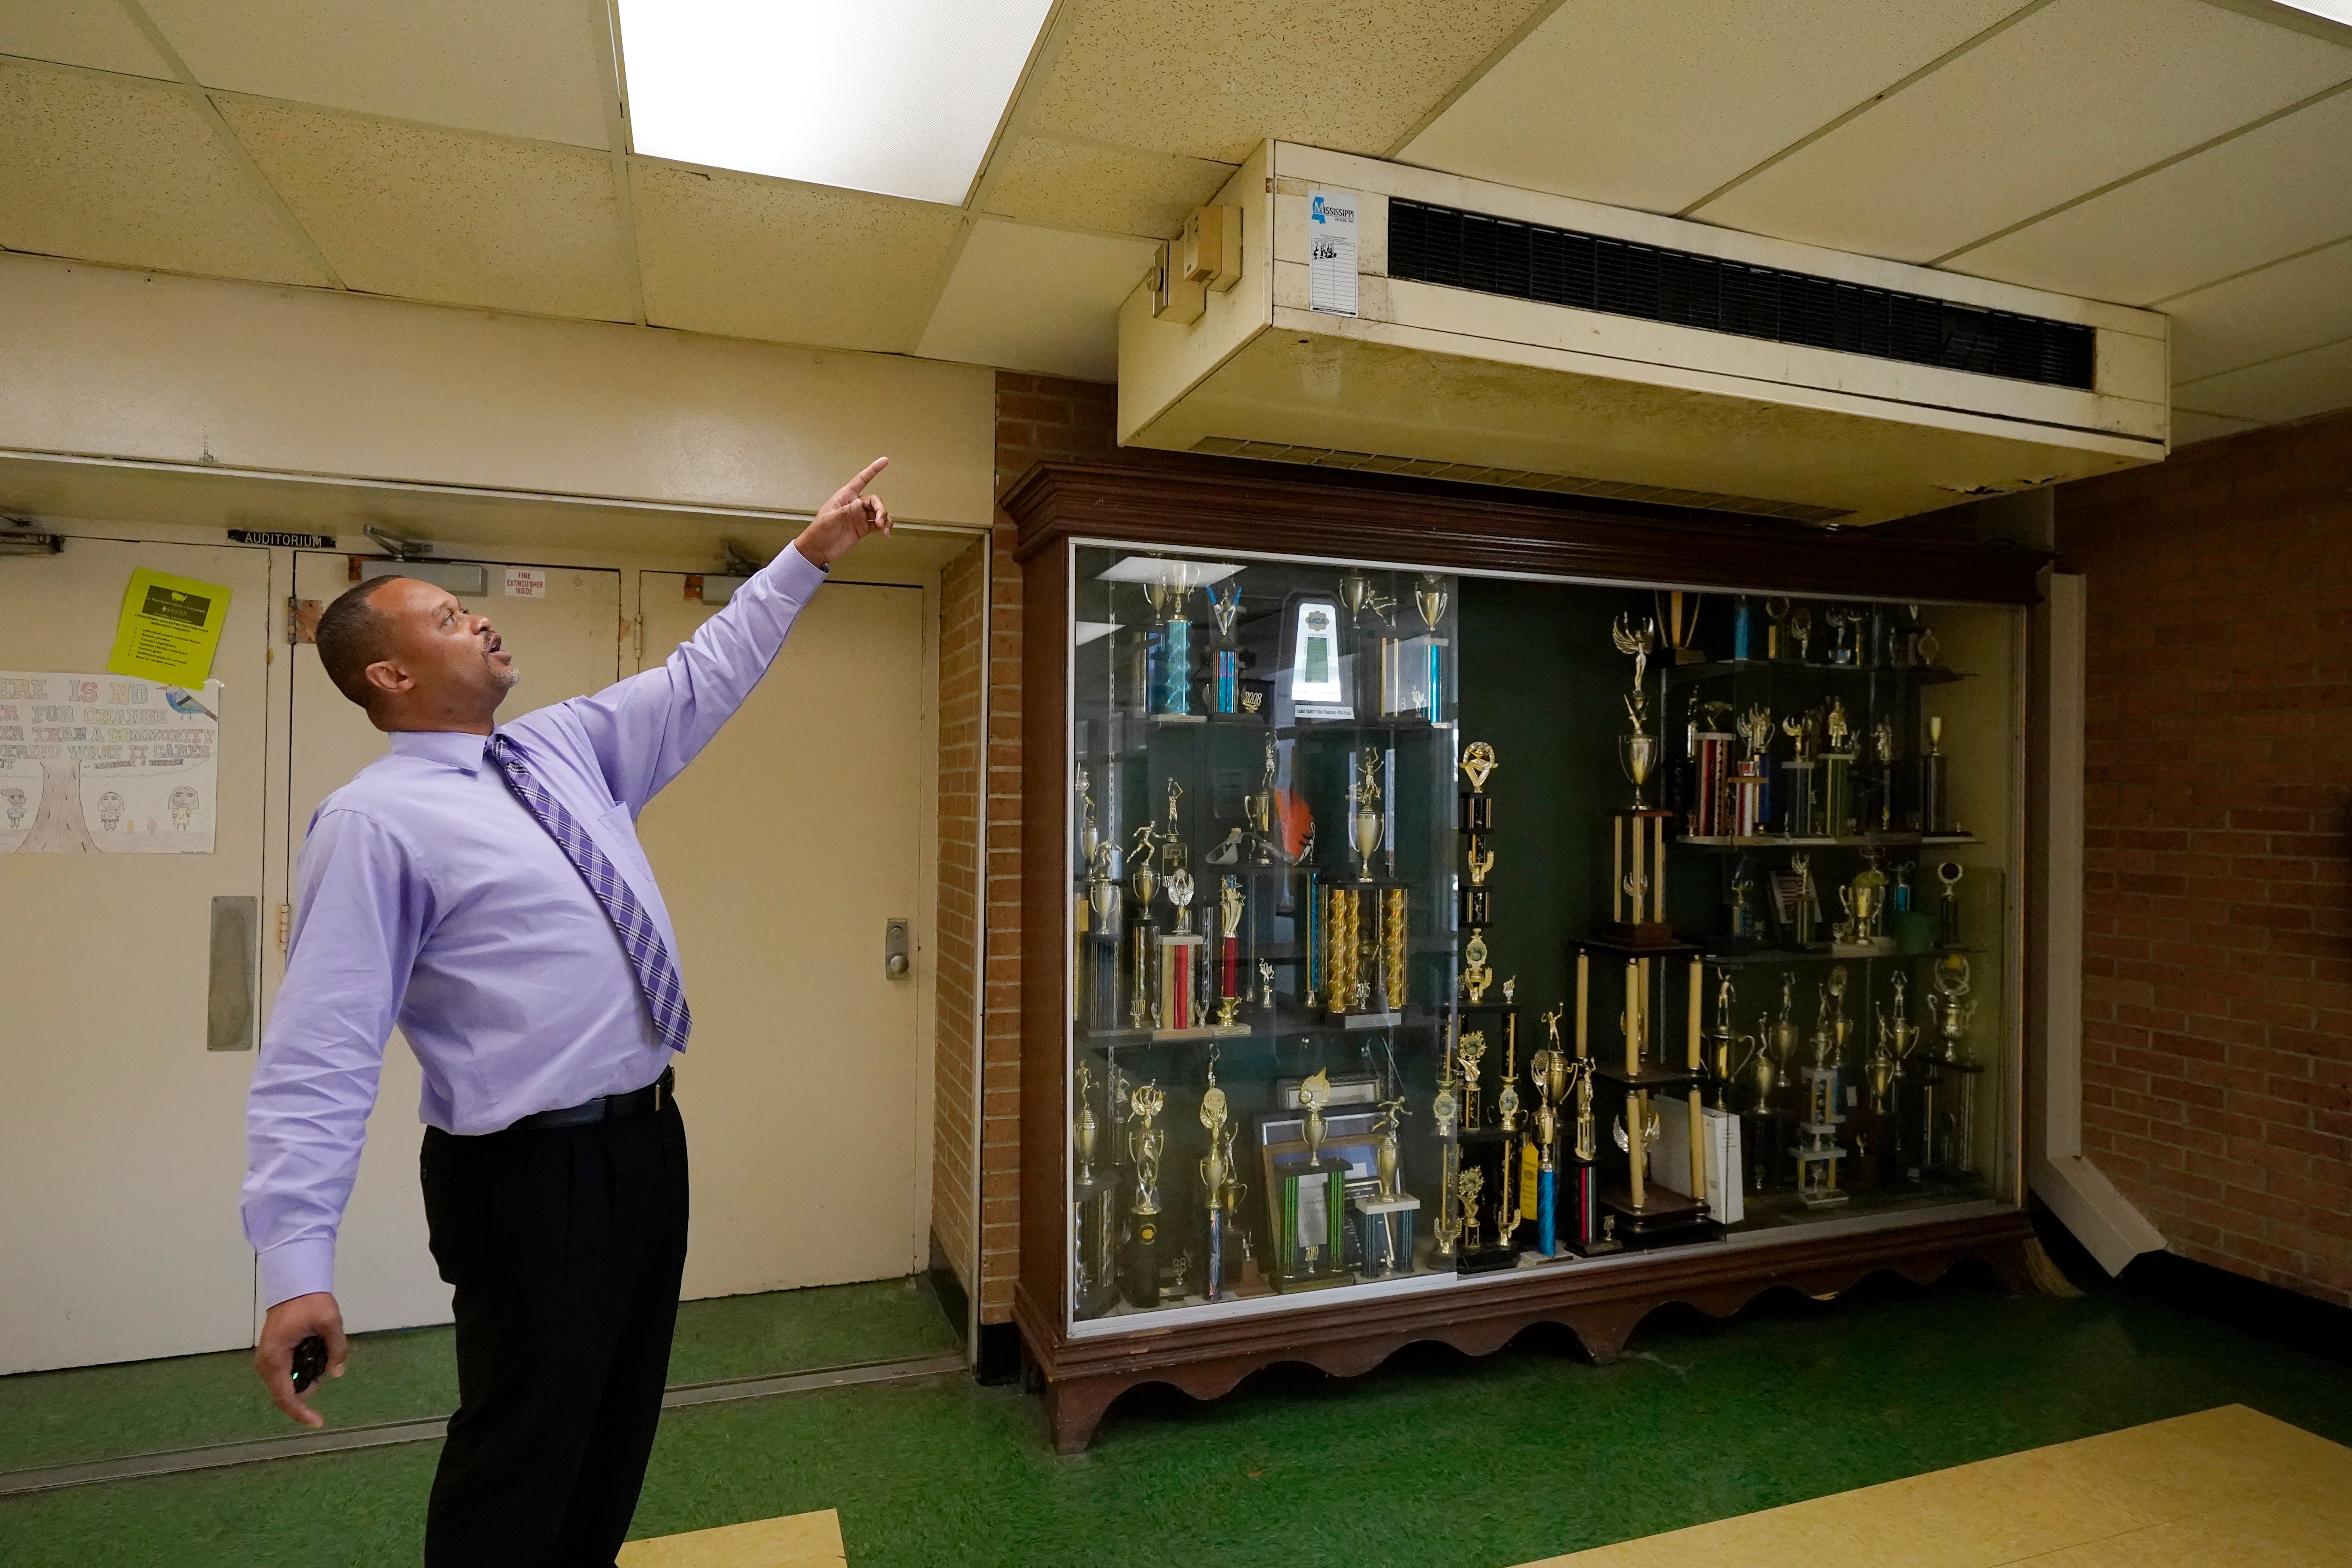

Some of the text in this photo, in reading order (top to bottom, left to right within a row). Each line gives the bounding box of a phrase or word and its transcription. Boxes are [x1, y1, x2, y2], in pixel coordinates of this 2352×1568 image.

[1314, 202, 1354, 218] MISSISSIPPI
[245, 532, 322, 548] AUDITORIUM
[507, 579, 543, 588] EXTINGUISHER
[69, 680, 98, 702] IS
[109, 683, 148, 705] NO
[1243, 691, 1262, 704] 2008
[32, 706, 75, 724] FOR
[84, 708, 169, 725] CHANGE
[91, 727, 105, 743] A
[108, 728, 216, 744] COMMUNITY
[67, 745, 123, 760] WHAT
[129, 745, 148, 760] IT
[153, 743, 211, 759] CARES
